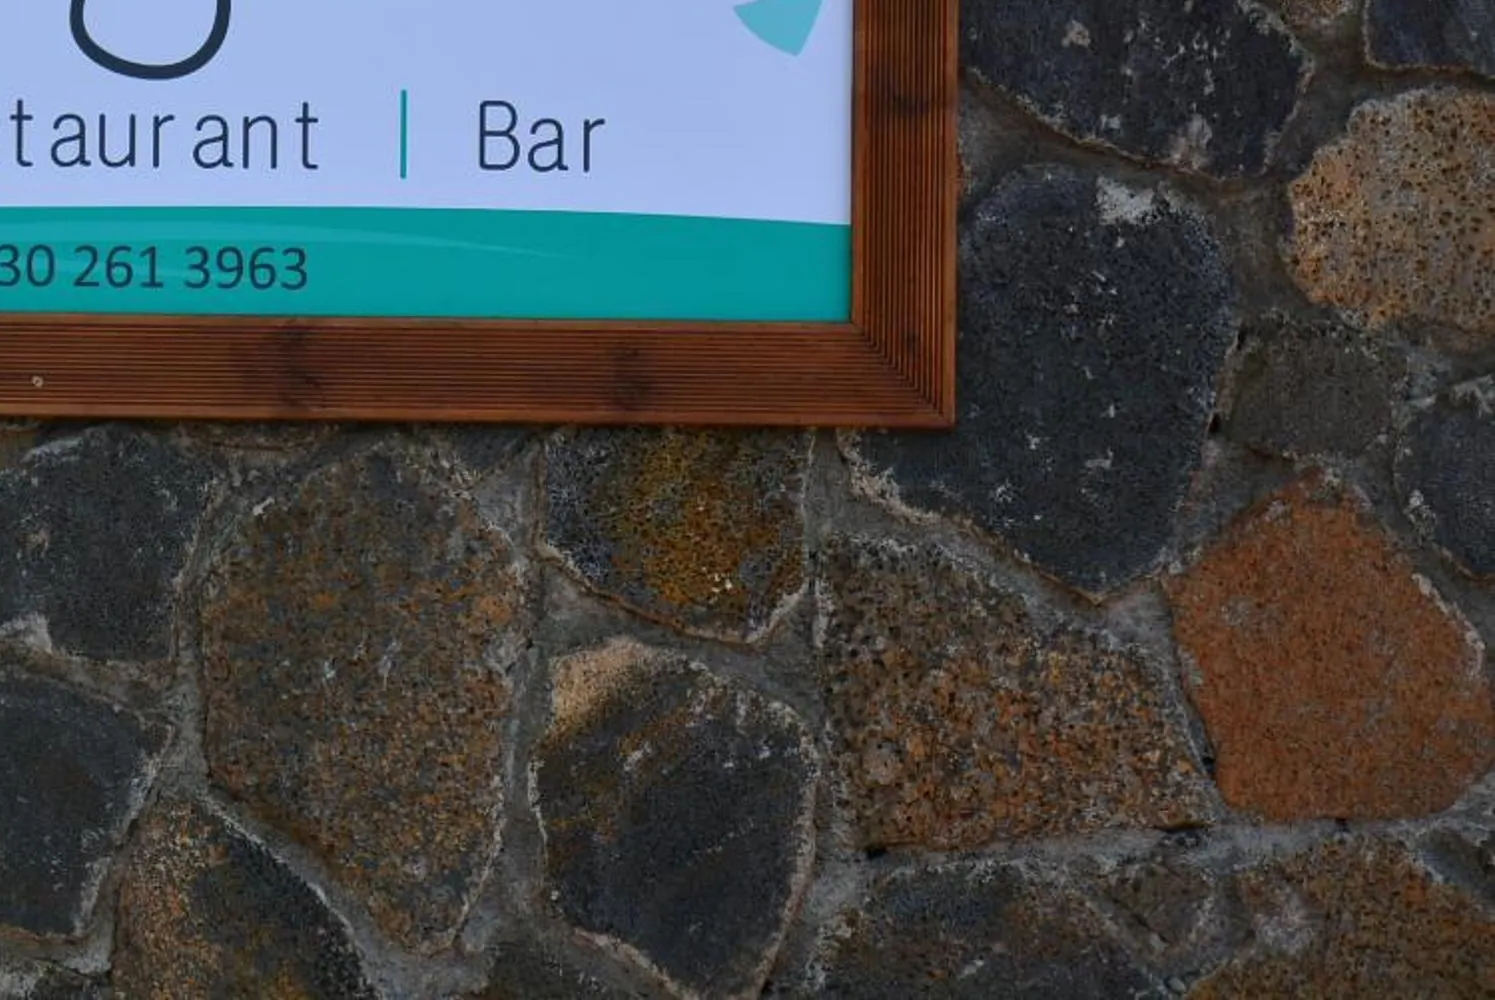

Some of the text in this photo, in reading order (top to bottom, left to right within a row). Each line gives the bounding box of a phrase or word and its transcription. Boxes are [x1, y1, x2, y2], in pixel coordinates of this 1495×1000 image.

[479, 100, 606, 173] Bar
[72, 245, 164, 289] 261
[183, 246, 308, 291] 3963
